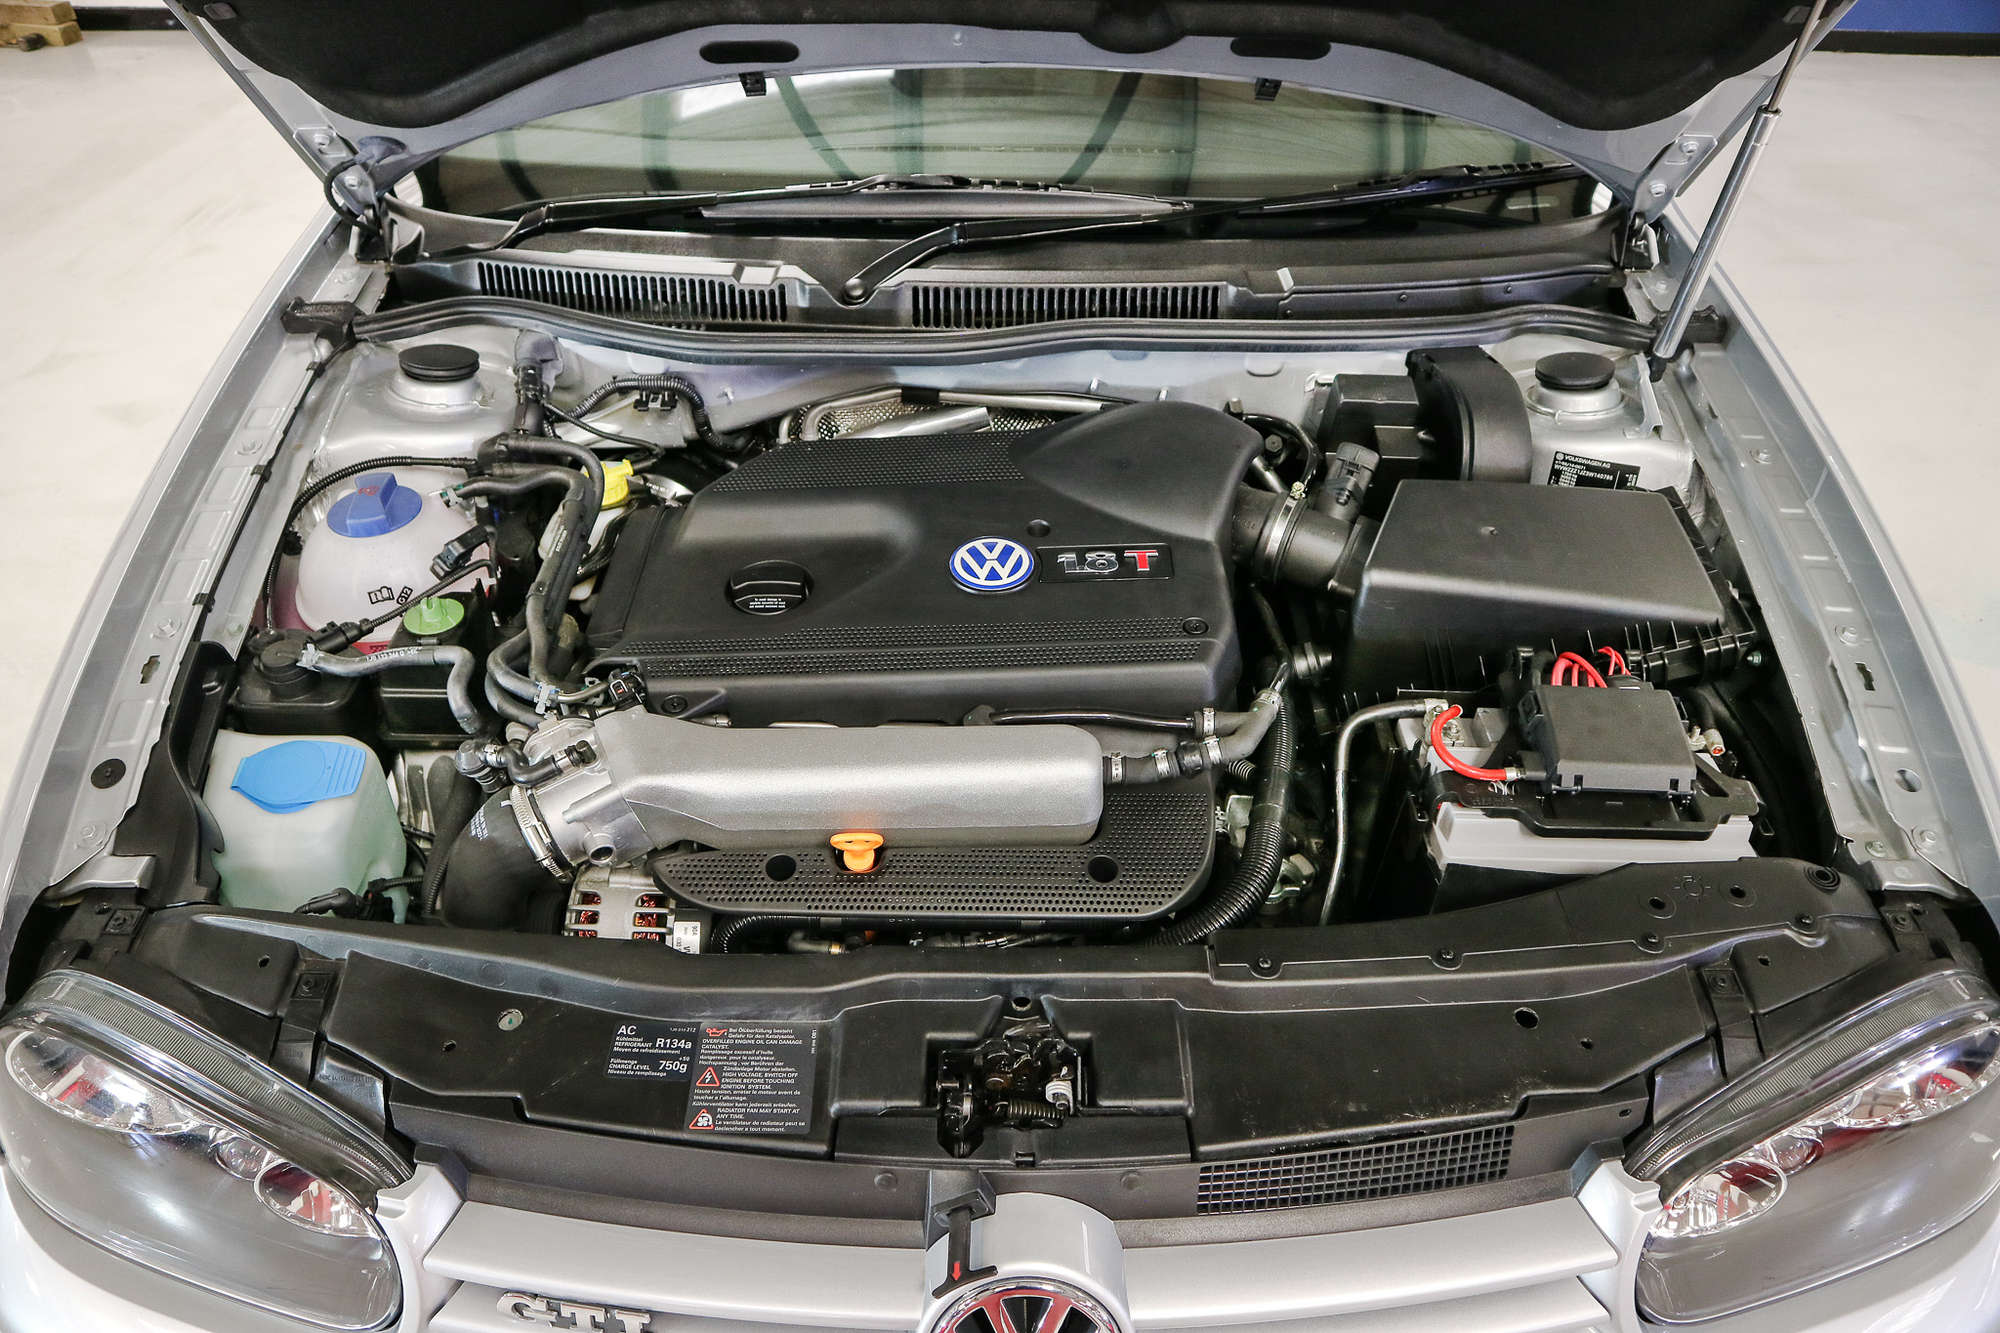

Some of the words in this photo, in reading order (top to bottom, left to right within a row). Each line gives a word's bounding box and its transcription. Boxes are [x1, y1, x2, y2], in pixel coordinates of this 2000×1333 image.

[398, 588, 411, 603] G12
[617, 1025, 636, 1034] AC
[656, 1038, 692, 1048] R134a
[658, 1060, 688, 1073] 750g
